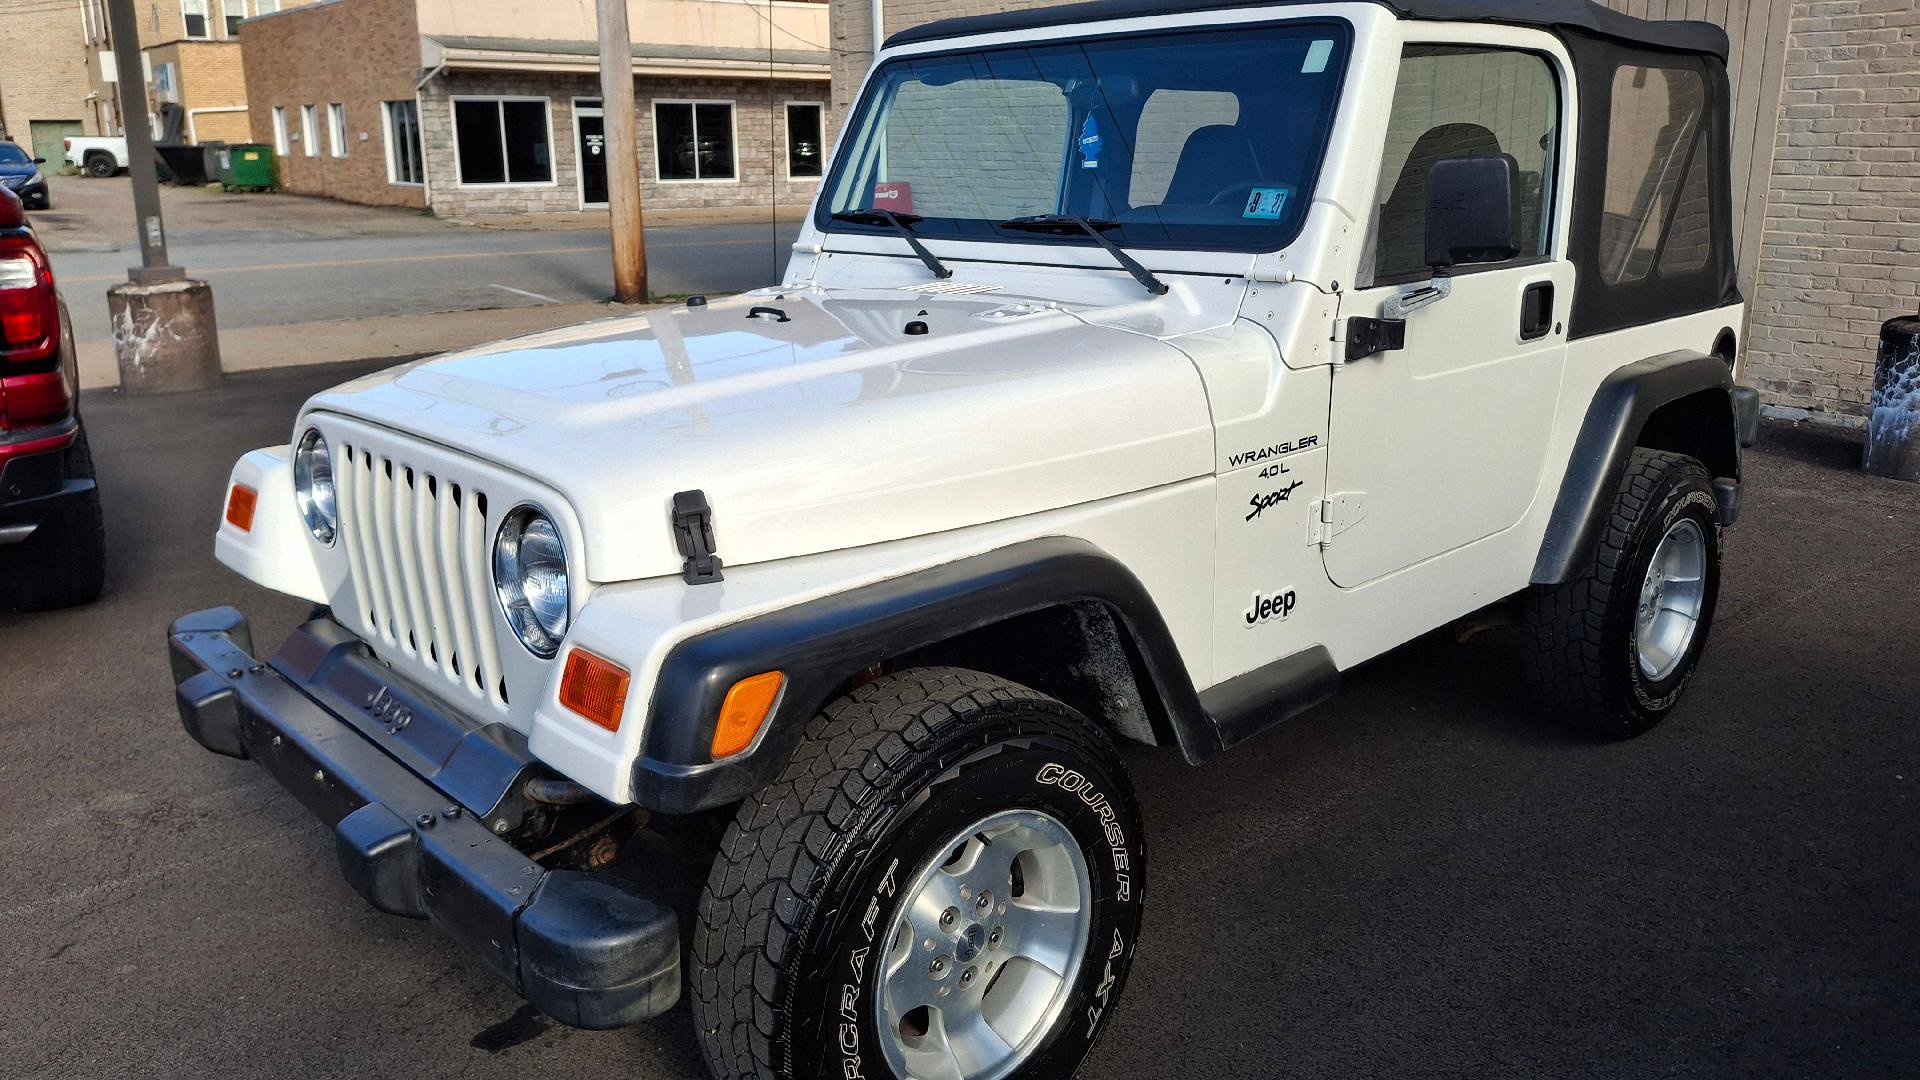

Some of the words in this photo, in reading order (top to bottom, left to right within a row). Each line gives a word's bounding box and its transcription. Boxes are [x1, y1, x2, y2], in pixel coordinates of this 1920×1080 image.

[1229, 435, 1318, 467] WRANGLER
[1245, 479, 1303, 522] Sport
[1246, 590, 1296, 624] Jeep
[1036, 762, 1130, 902] COURSER
[1085, 927, 1124, 1039] AXT
